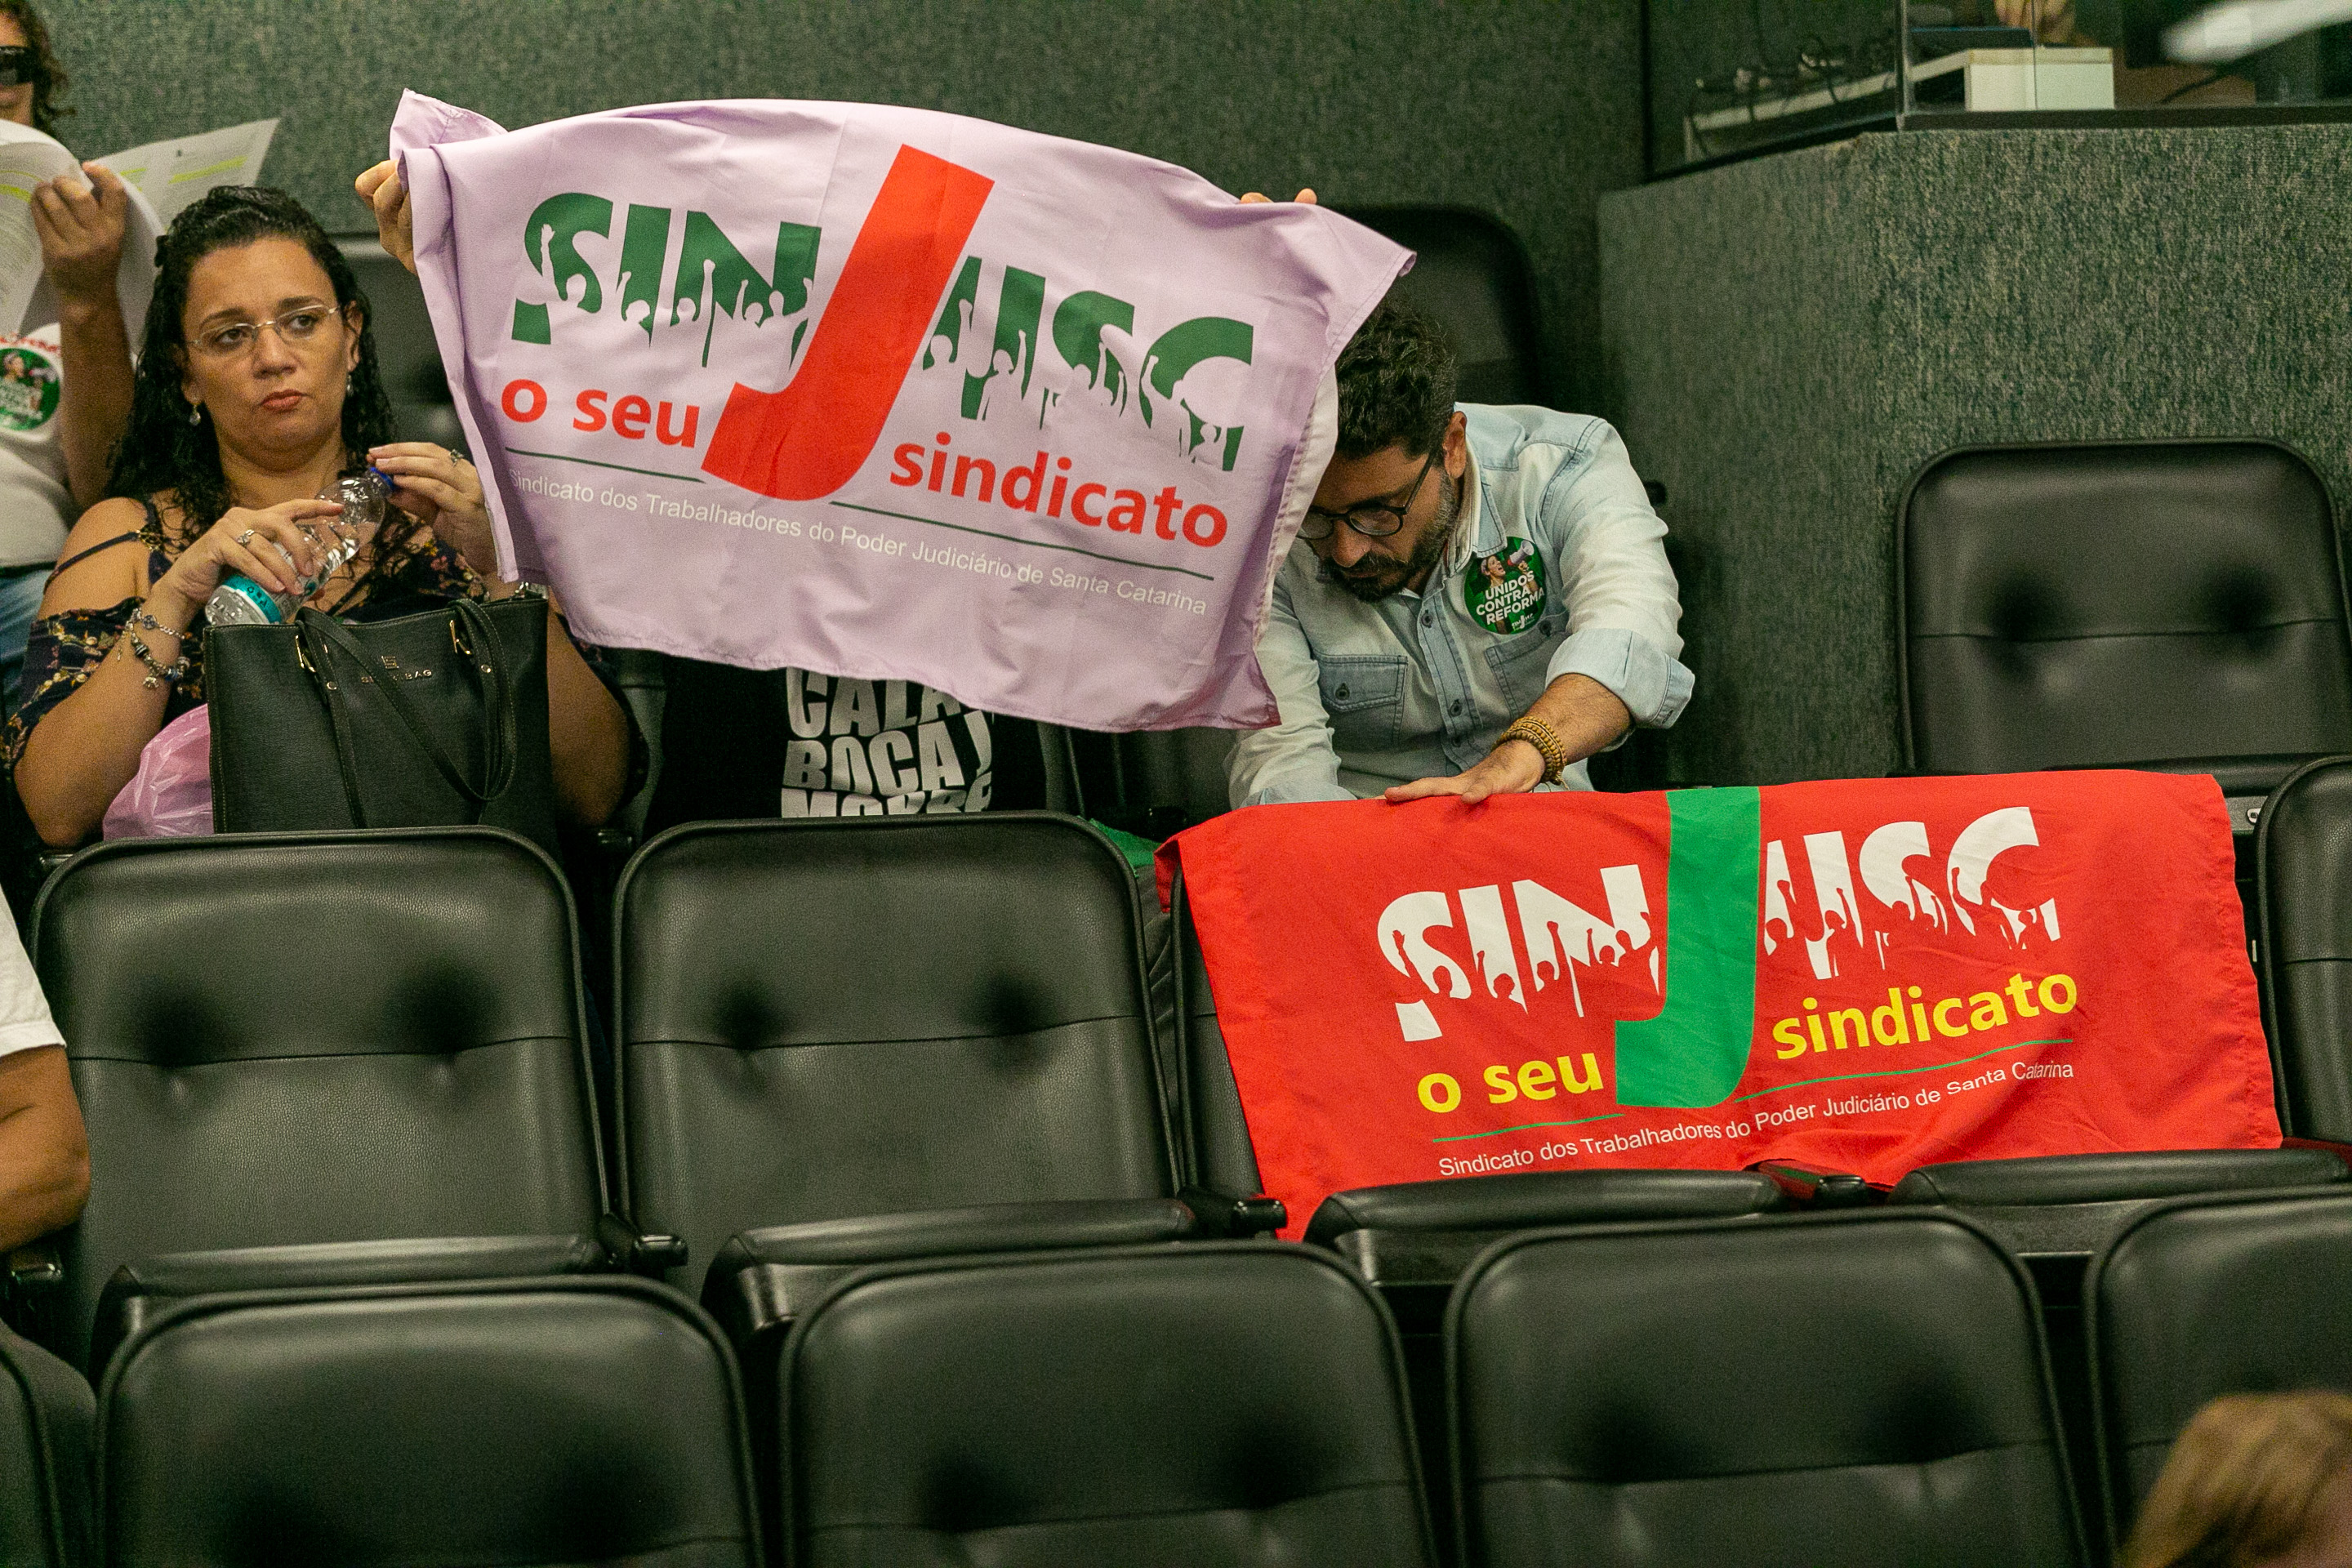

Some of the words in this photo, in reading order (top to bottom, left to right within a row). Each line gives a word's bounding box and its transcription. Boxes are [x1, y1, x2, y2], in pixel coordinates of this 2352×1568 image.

[501, 379, 547, 423] o
[573, 389, 700, 448] seu
[889, 431, 1228, 548] sindicato
[509, 468, 595, 503] Sindicato
[600, 486, 639, 511] dos
[646, 493, 802, 537] Trabalhadores
[808, 521, 835, 542] do
[840, 526, 907, 556] Poder
[911, 541, 1012, 578] Judiciário
[1017, 564, 1045, 584] de
[1050, 567, 1110, 595] Santa
[1116, 579, 1207, 616] Catarina
[1485, 570, 1534, 599] UNIDOS
[1476, 586, 1530, 616] CONTRA
[1486, 587, 1545, 626] REFORMA
[782, 720, 965, 797] BOCA
[1417, 1072, 1462, 1113] o
[1483, 1053, 1604, 1104] seu
[1772, 973, 2078, 1060] sindicato
[1438, 1149, 1535, 1176] Sindicato
[1540, 1142, 1579, 1160] dos
[1580, 1124, 1722, 1155] Trabalhadores
[1726, 1120, 1751, 1139] do
[1755, 1105, 1817, 1131] Poder
[1823, 1091, 1910, 1117] Judiciário
[1915, 1088, 1942, 1107] de
[1946, 1067, 2007, 1095] Santa
[2011, 1062, 2074, 1081] Catarina
